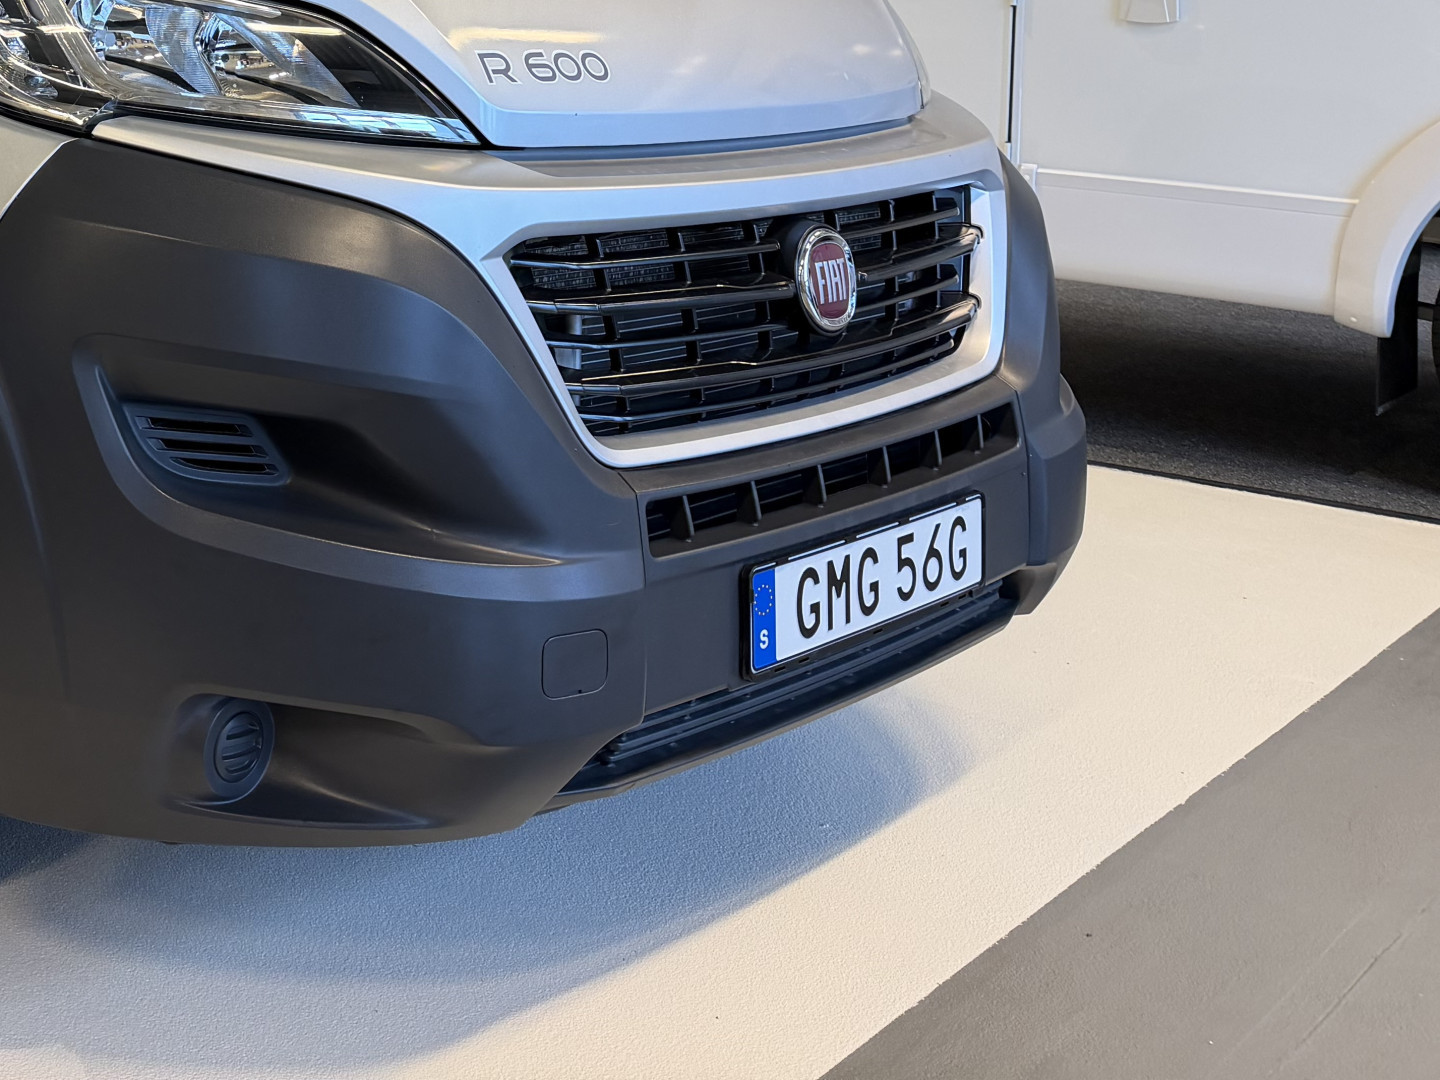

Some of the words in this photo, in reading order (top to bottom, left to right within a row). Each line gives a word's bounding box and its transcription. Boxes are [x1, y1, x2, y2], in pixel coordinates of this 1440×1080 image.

[475, 50, 521, 84] R
[522, 49, 610, 83] 600
[814, 258, 848, 305] FIAT
[796, 546, 880, 639] GMG
[896, 515, 968, 602] 56G
[759, 628, 769, 650] S
